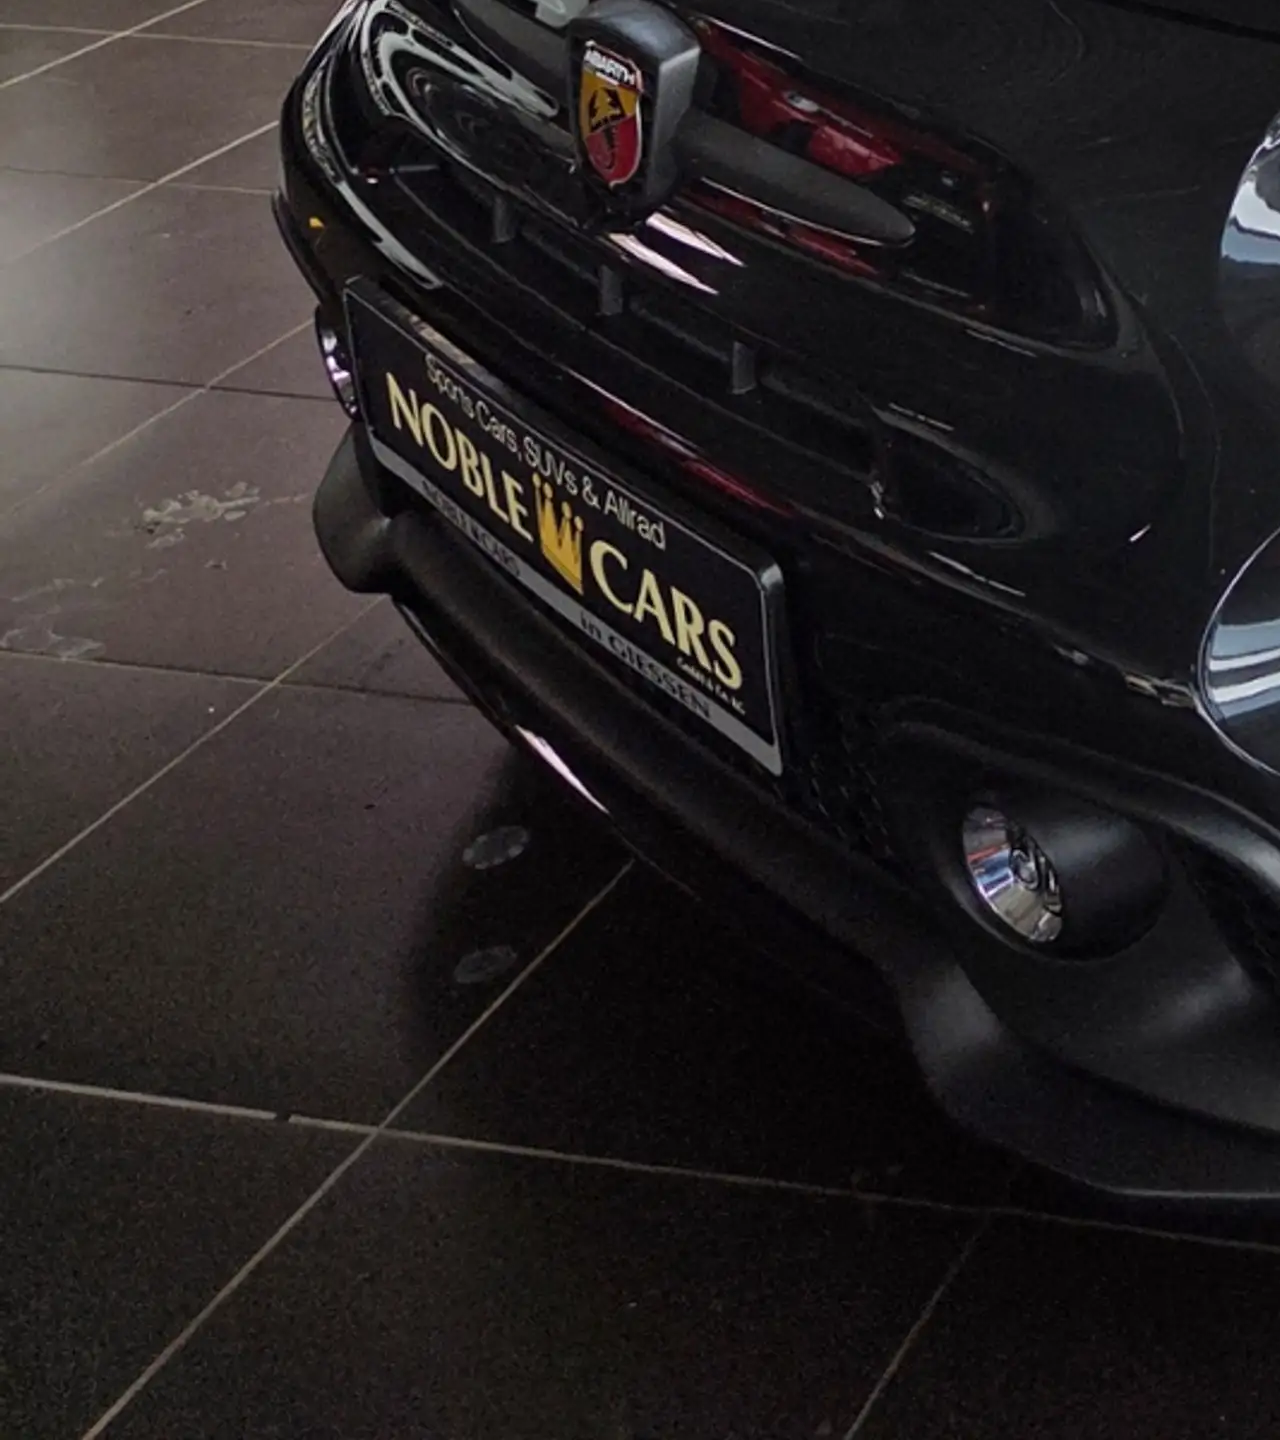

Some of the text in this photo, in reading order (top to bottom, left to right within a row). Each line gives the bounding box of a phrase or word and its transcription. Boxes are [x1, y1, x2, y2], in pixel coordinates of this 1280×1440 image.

[385, 371, 535, 543] NOBLE
[591, 541, 743, 690] CARS
[425, 353, 666, 551] Sports Cars, SUVs & Allrad
[608, 635, 711, 718] GIESSEN
